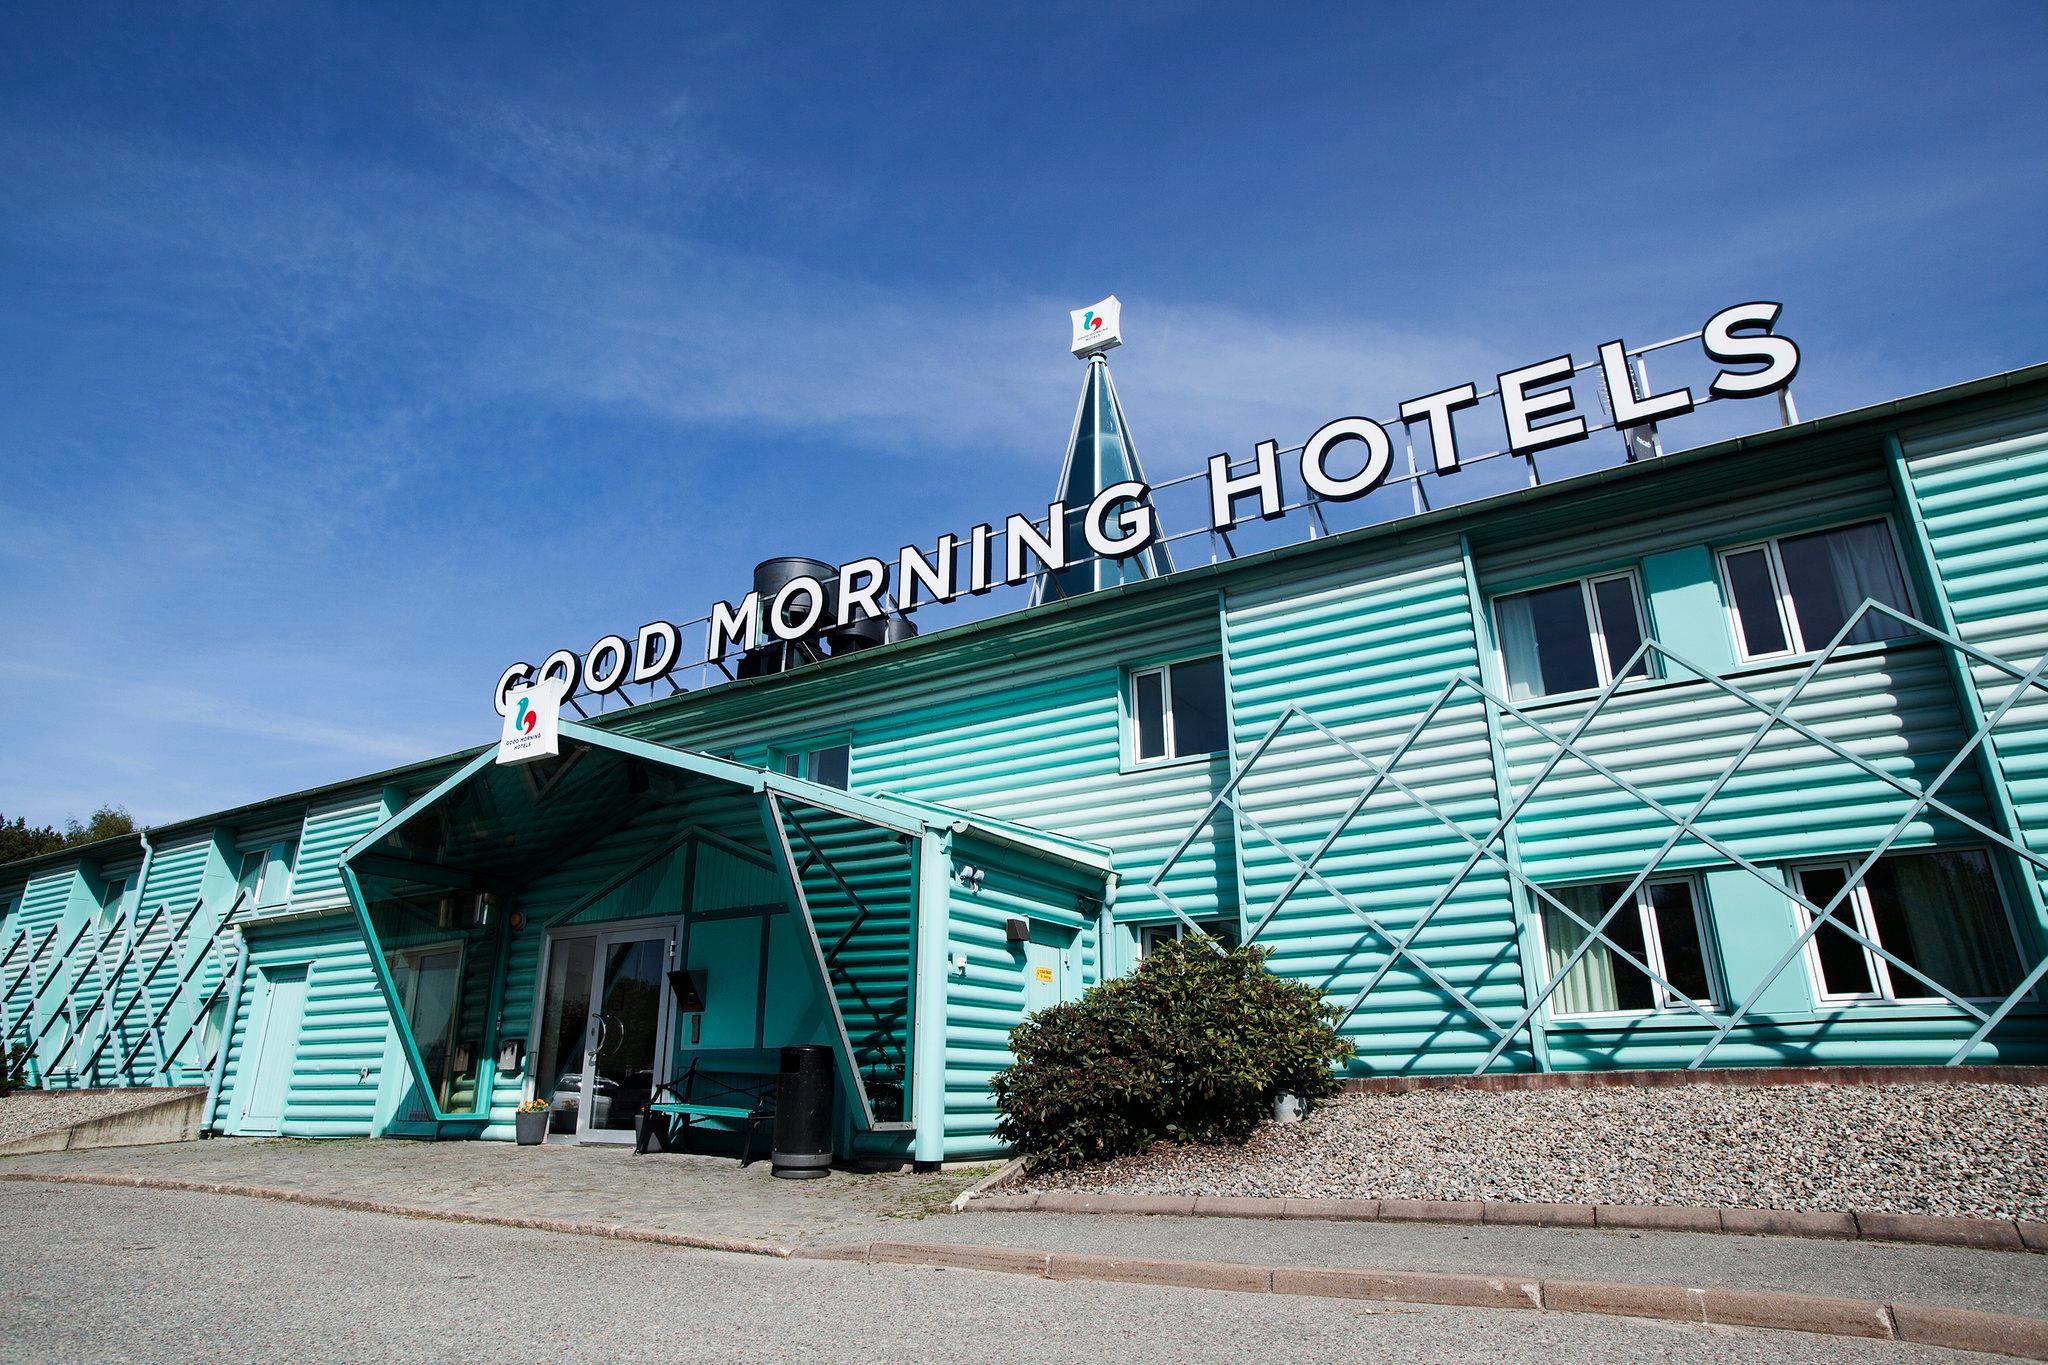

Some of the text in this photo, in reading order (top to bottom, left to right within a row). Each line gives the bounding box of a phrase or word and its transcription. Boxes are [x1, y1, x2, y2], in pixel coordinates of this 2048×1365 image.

[494, 301, 1800, 717] GOOD MORNING HOTELS
